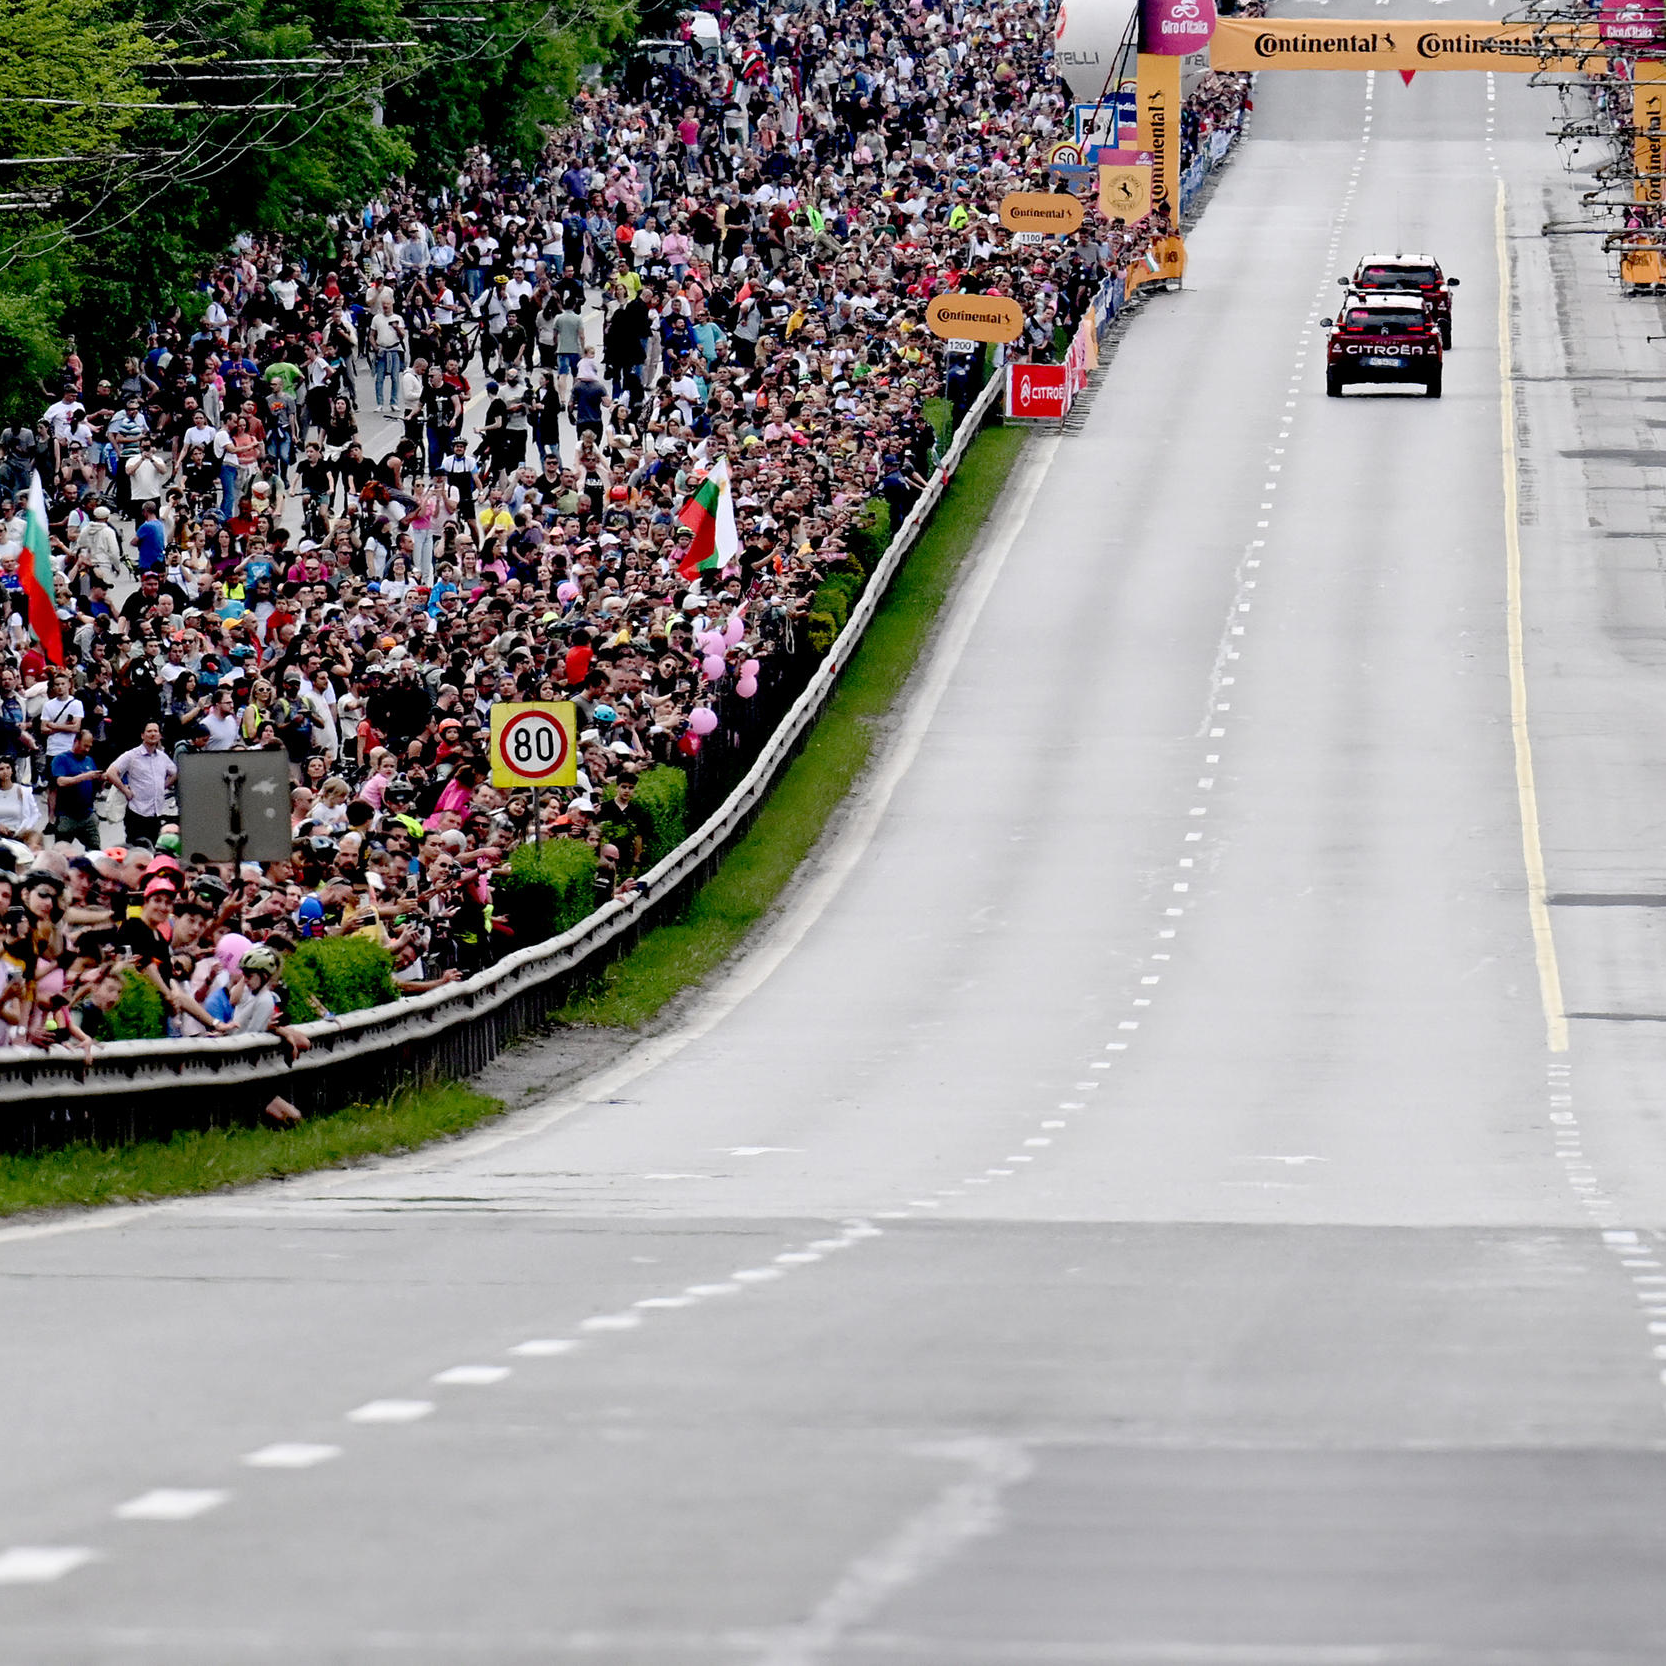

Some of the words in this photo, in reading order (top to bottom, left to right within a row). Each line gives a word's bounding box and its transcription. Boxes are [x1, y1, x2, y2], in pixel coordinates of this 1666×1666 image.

[1161, 20, 1178, 34] Giro
[1180, 19, 1209, 34] d'Italia
[1254, 32, 1377, 57] Continental
[1010, 206, 1064, 219] Continental
[1022, 234, 1040, 242] 1100
[937, 308, 1001, 324] Continental
[949, 341, 971, 350] 1200
[1346, 344, 1423, 355] CITROËN
[1032, 384, 1065, 400] CITROË
[514, 726, 554, 762] 80
